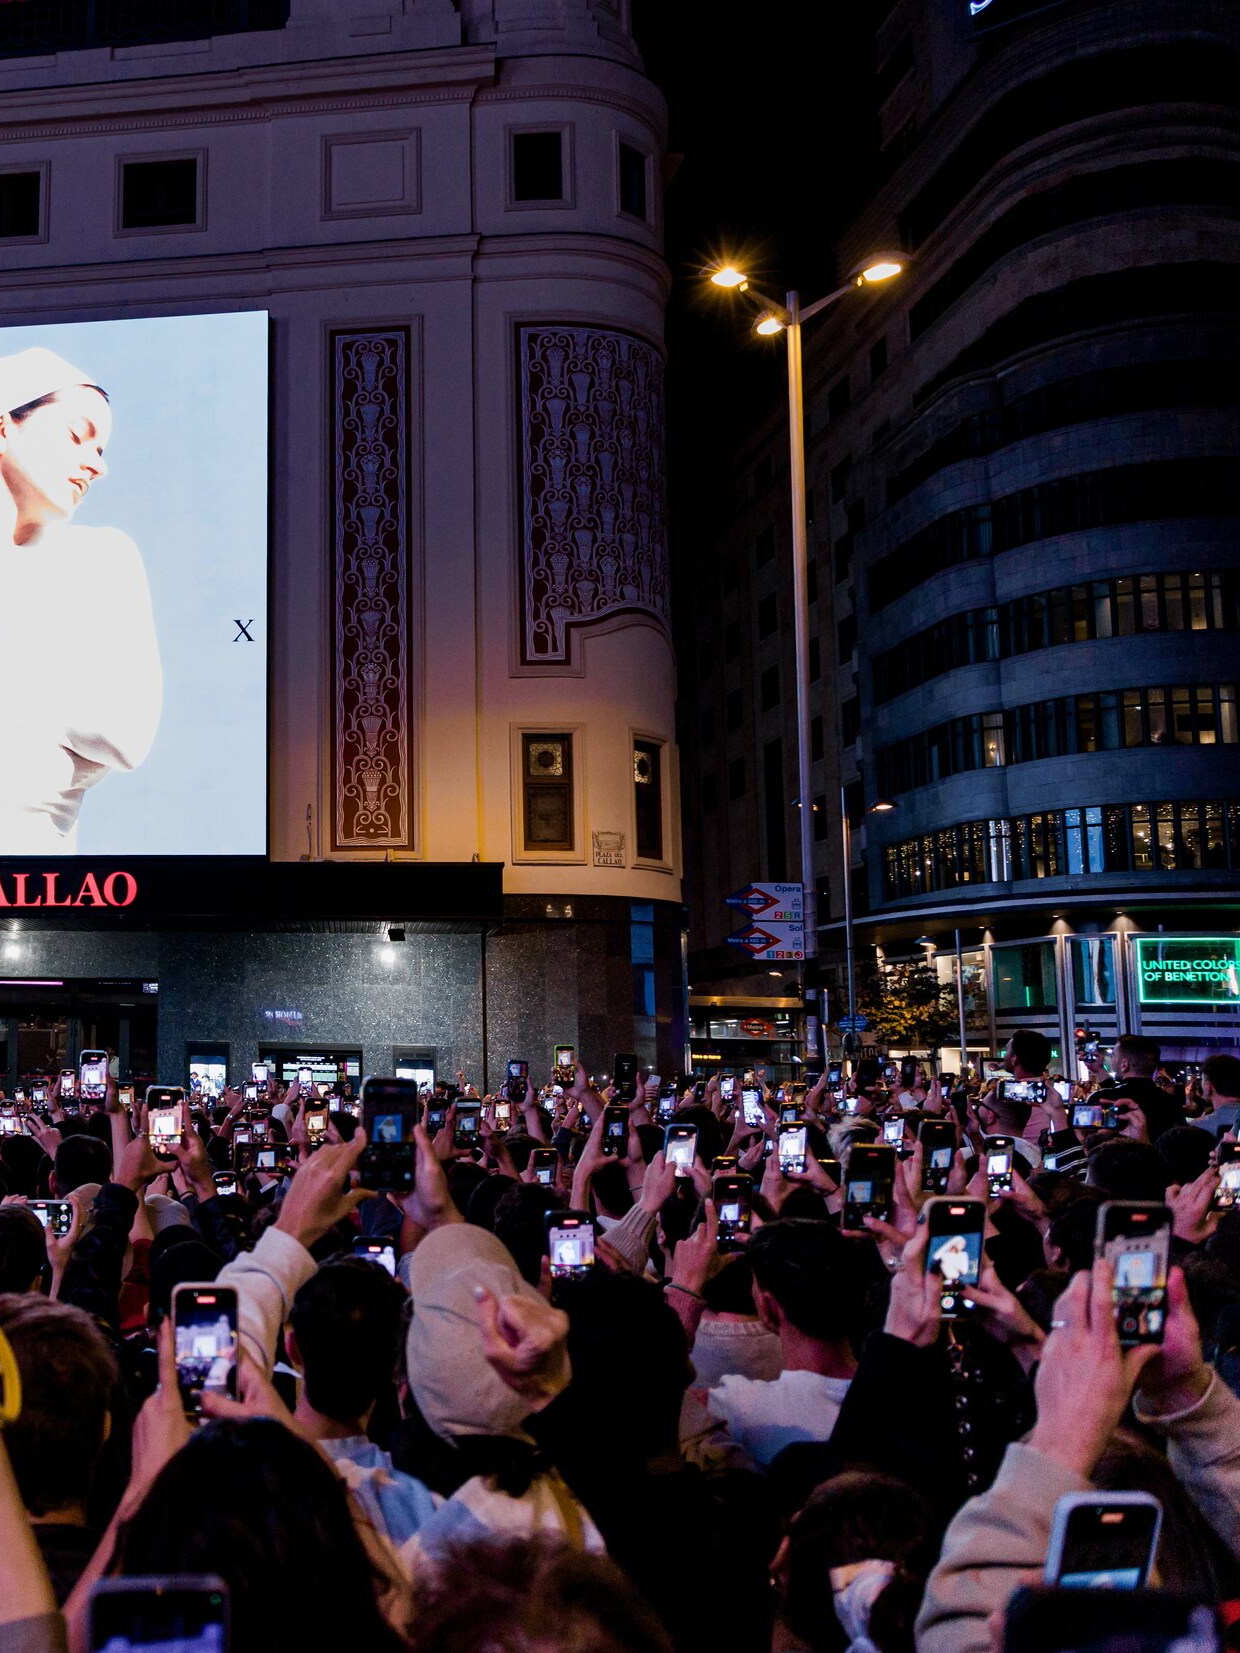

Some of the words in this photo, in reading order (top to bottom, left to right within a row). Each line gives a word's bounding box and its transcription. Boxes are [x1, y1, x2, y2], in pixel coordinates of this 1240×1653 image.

[232, 619, 255, 642] X
[774, 884, 801, 893] Ópera
[788, 924, 803, 932] Sol
[1142, 960, 1190, 970] UNITED
[1144, 971, 1162, 981] OF
[1165, 971, 1230, 981] BENETTON
